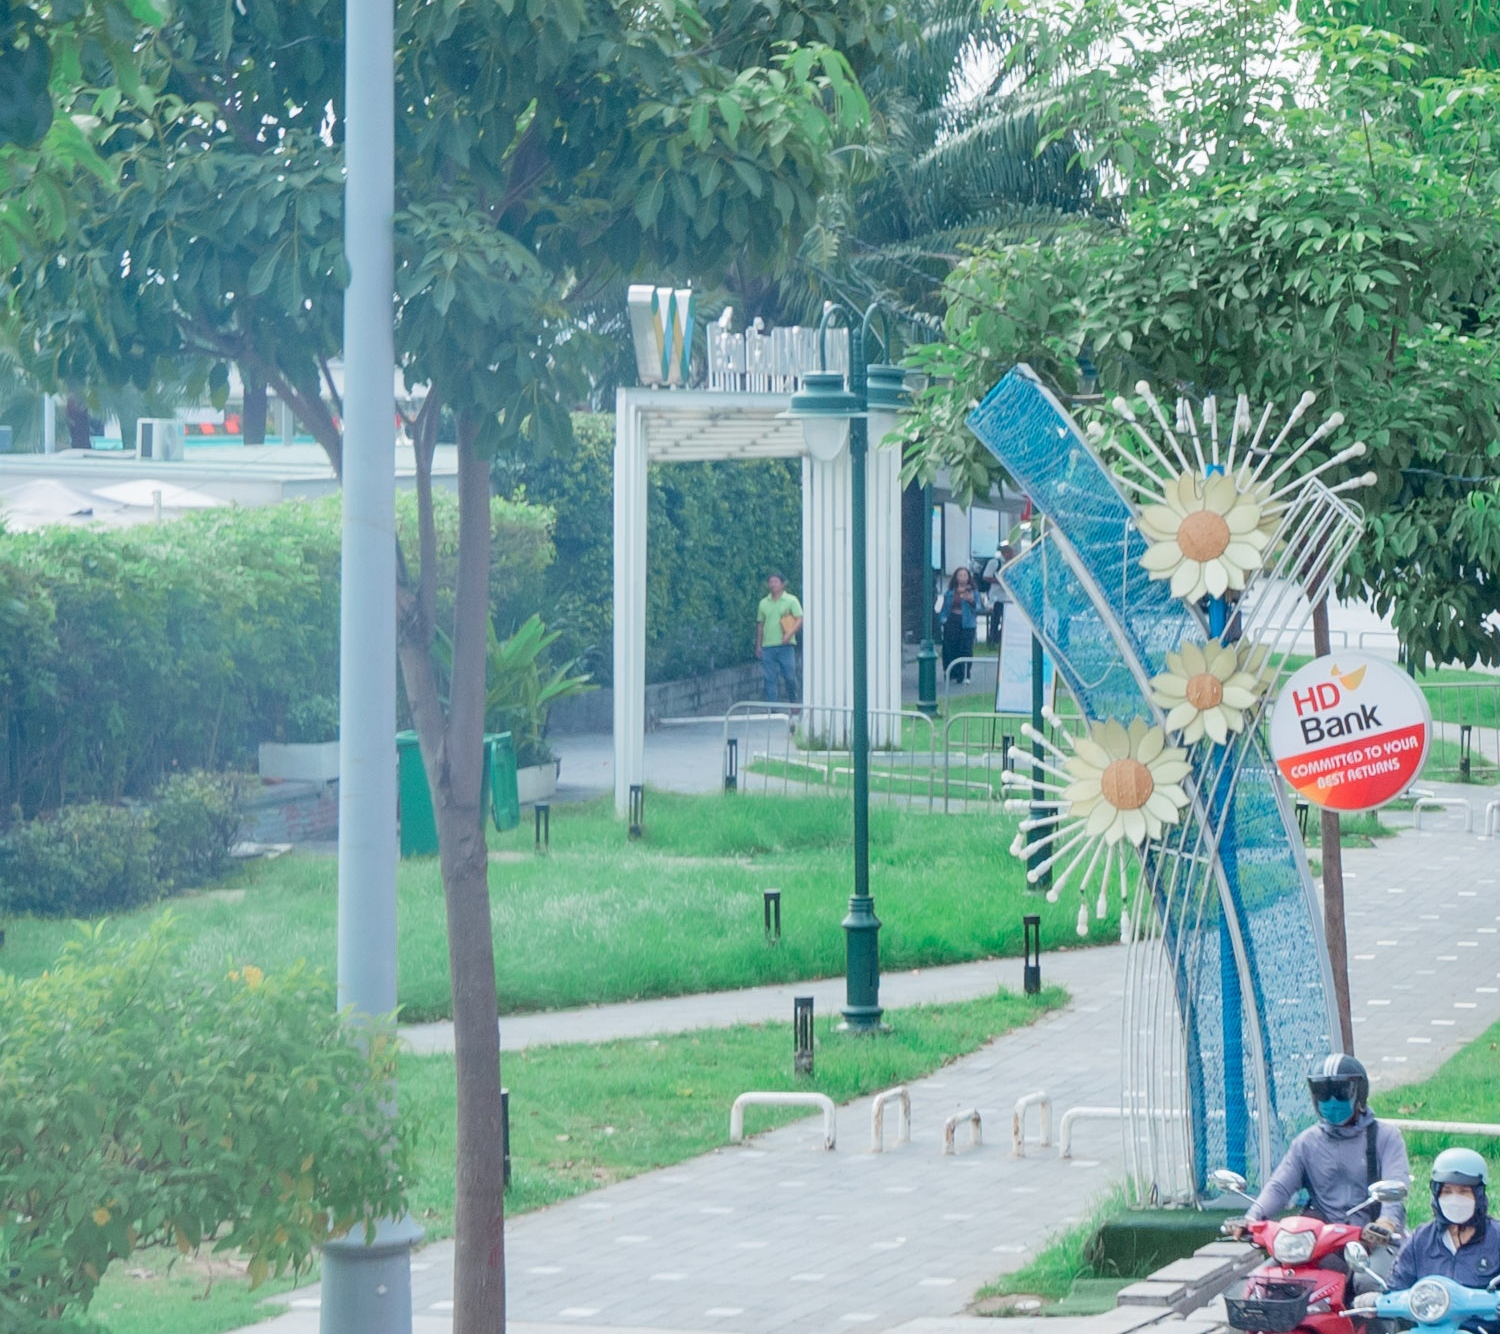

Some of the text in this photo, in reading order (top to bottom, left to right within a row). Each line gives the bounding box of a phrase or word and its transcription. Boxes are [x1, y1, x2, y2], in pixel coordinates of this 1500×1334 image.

[1292, 682, 1341, 717] HD
[1300, 703, 1383, 745] Bank
[1290, 735, 1419, 779] COMMITTED TO YOUR
[1317, 757, 1400, 789] BEST RETURNS
